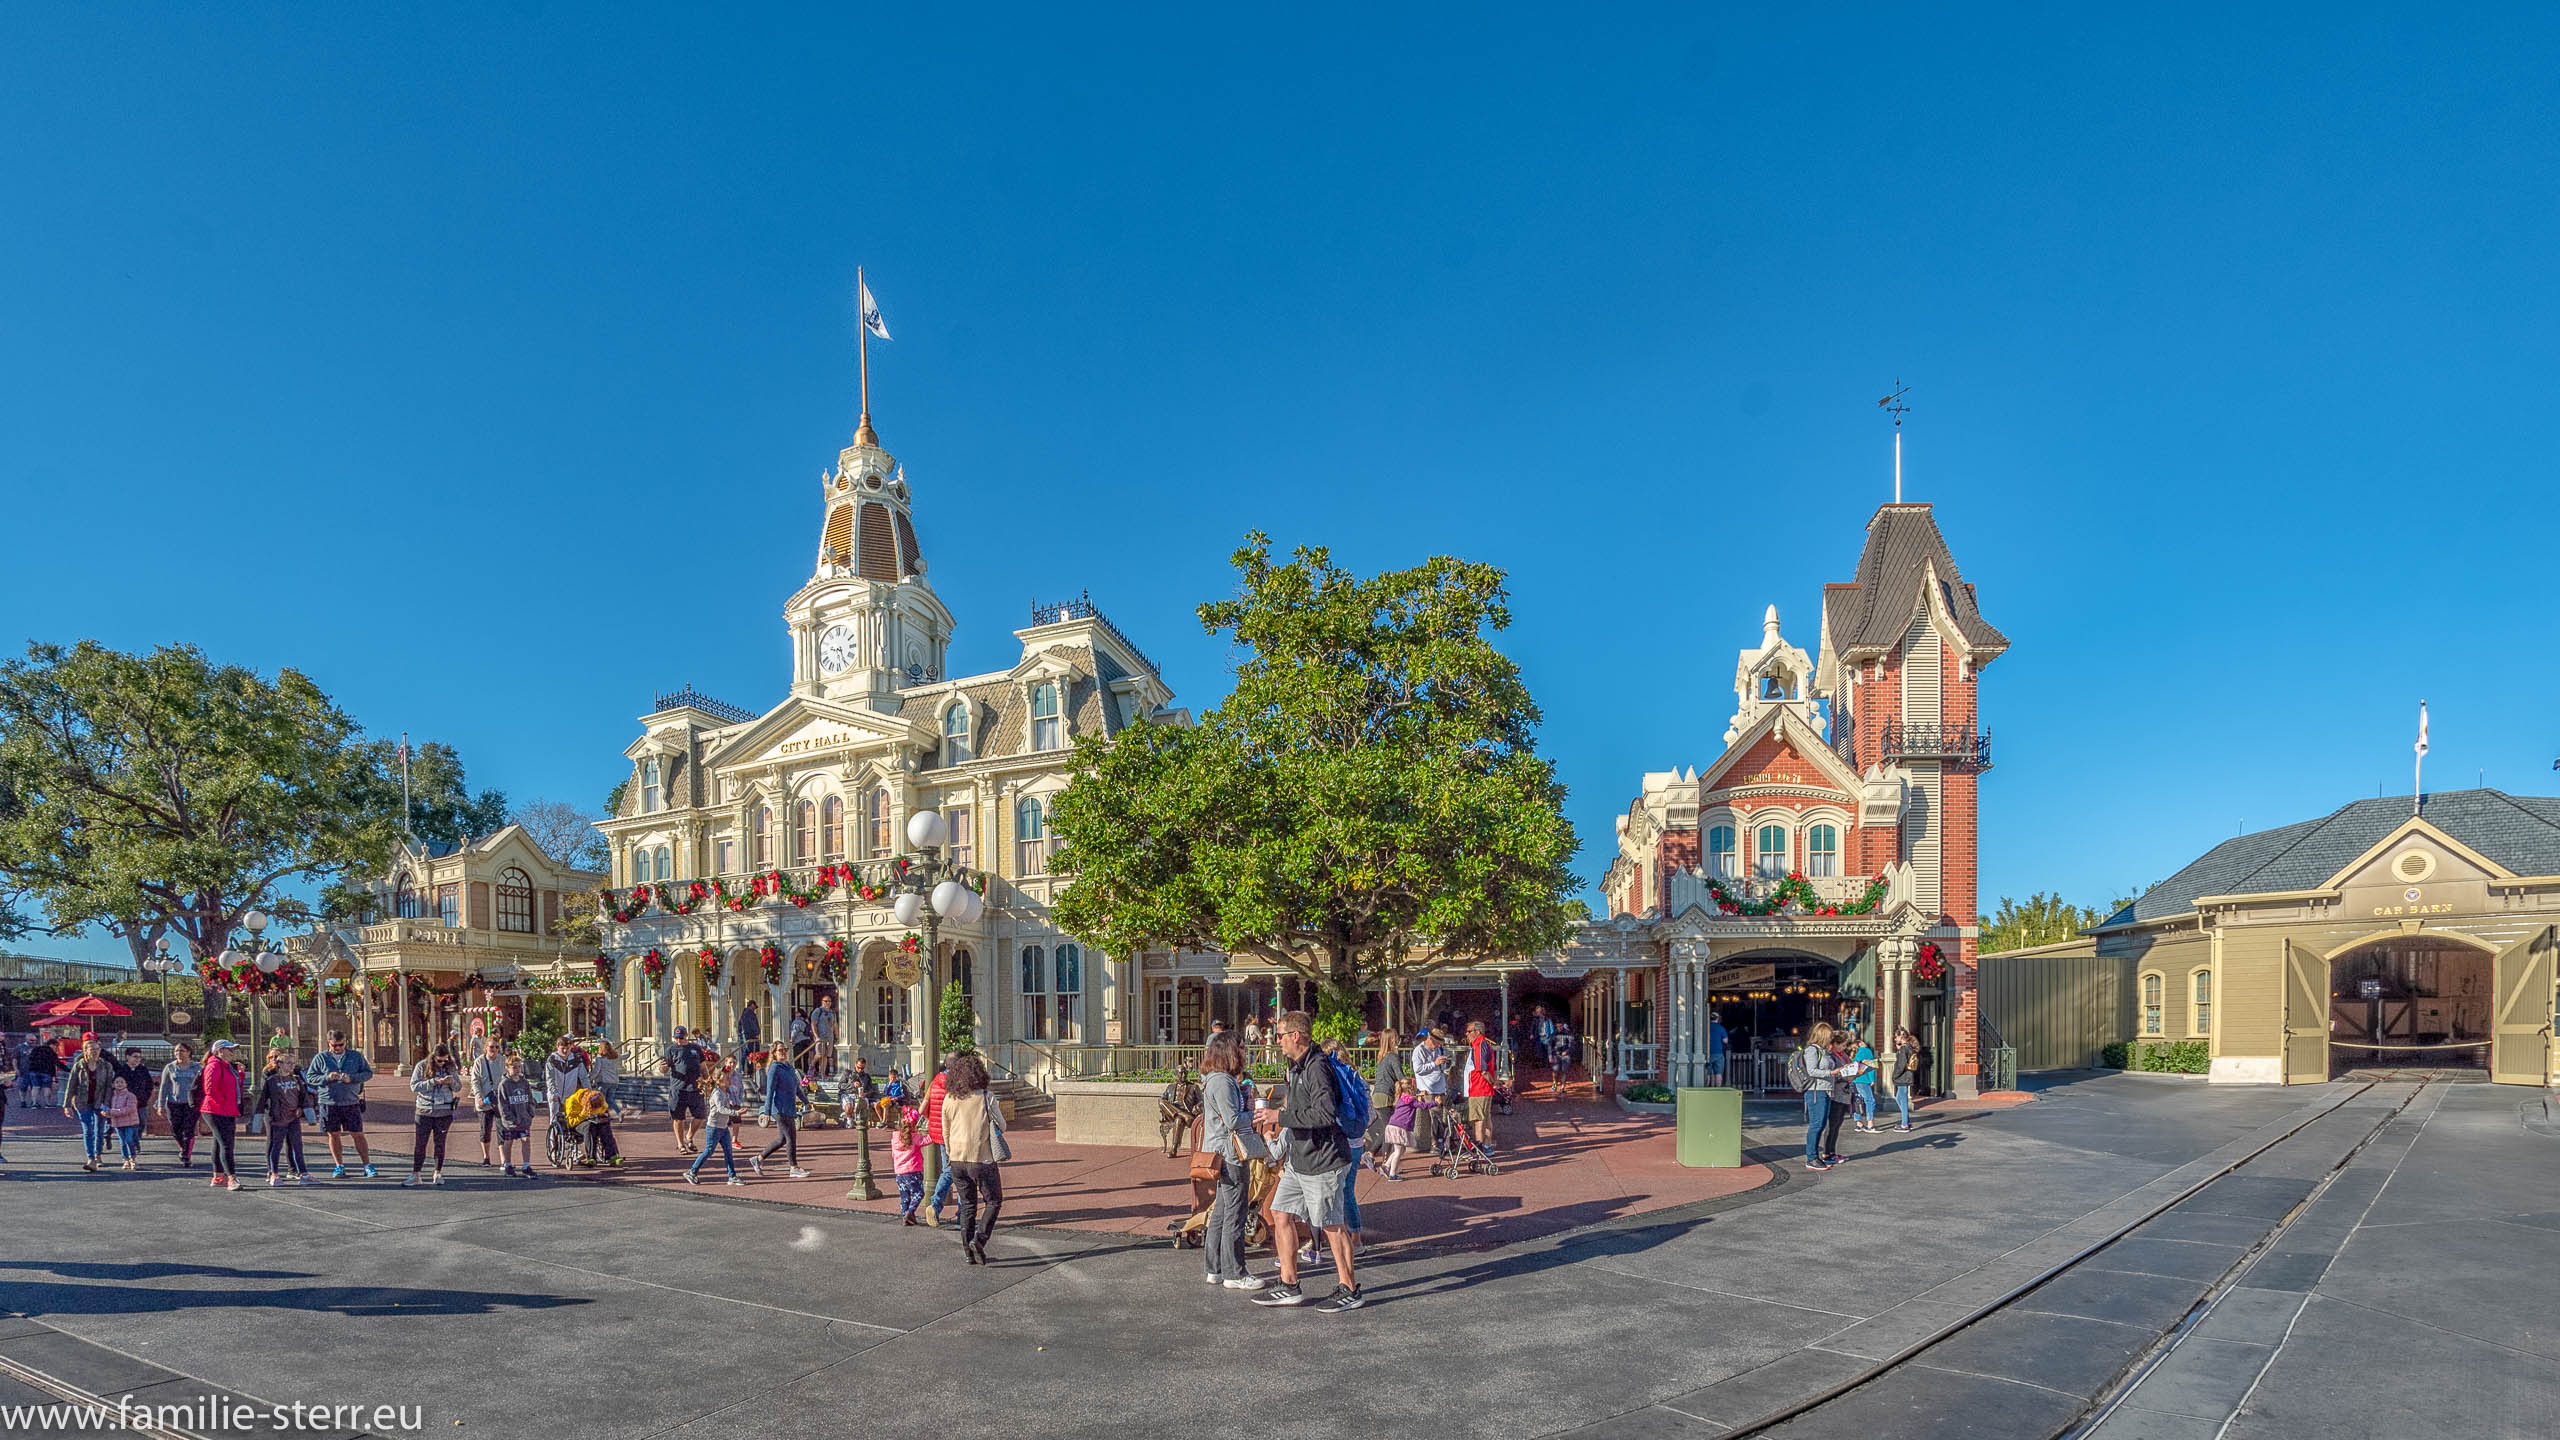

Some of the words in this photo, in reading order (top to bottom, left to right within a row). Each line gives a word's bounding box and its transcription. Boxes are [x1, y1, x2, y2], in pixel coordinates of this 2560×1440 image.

[781, 739, 810, 753] CITY
[814, 732, 850, 748] HALL
[2373, 906, 2403, 916] CAR
[2409, 903, 2453, 914] BARN
